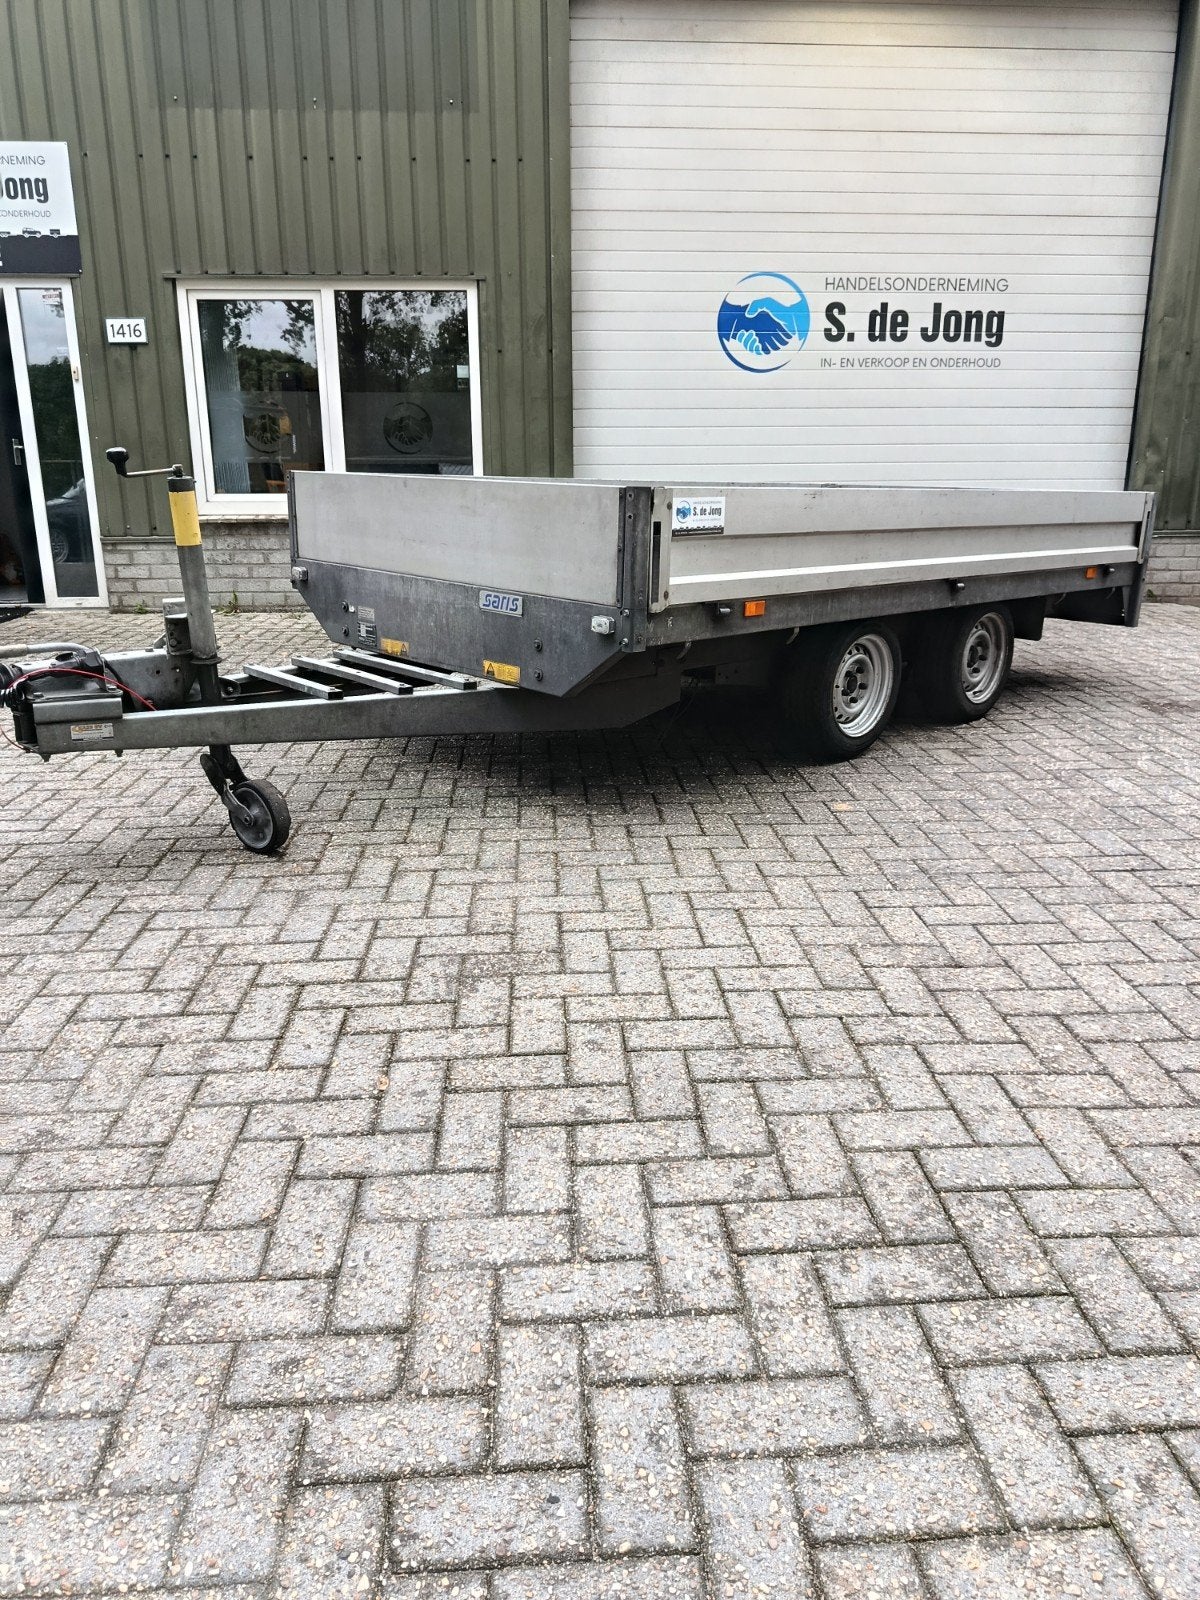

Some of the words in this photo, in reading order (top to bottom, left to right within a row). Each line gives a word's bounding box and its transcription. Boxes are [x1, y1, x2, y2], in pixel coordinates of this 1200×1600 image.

[0, 155, 46, 166] NEMING
[0, 175, 49, 203] ong
[825, 277, 1009, 292] HANDELSONDERNEMING
[110, 324, 142, 338] 1416
[824, 302, 855, 343] S.
[868, 302, 910, 343] de
[920, 302, 1006, 348] Jong
[820, 358, 837, 368] IN-
[840, 358, 854, 368] EN
[857, 358, 910, 369] VERKOOP
[912, 358, 927, 368] EN
[930, 357, 1001, 368] ONDERHOUD
[700, 506, 707, 516] de
[708, 506, 722, 517] Jong
